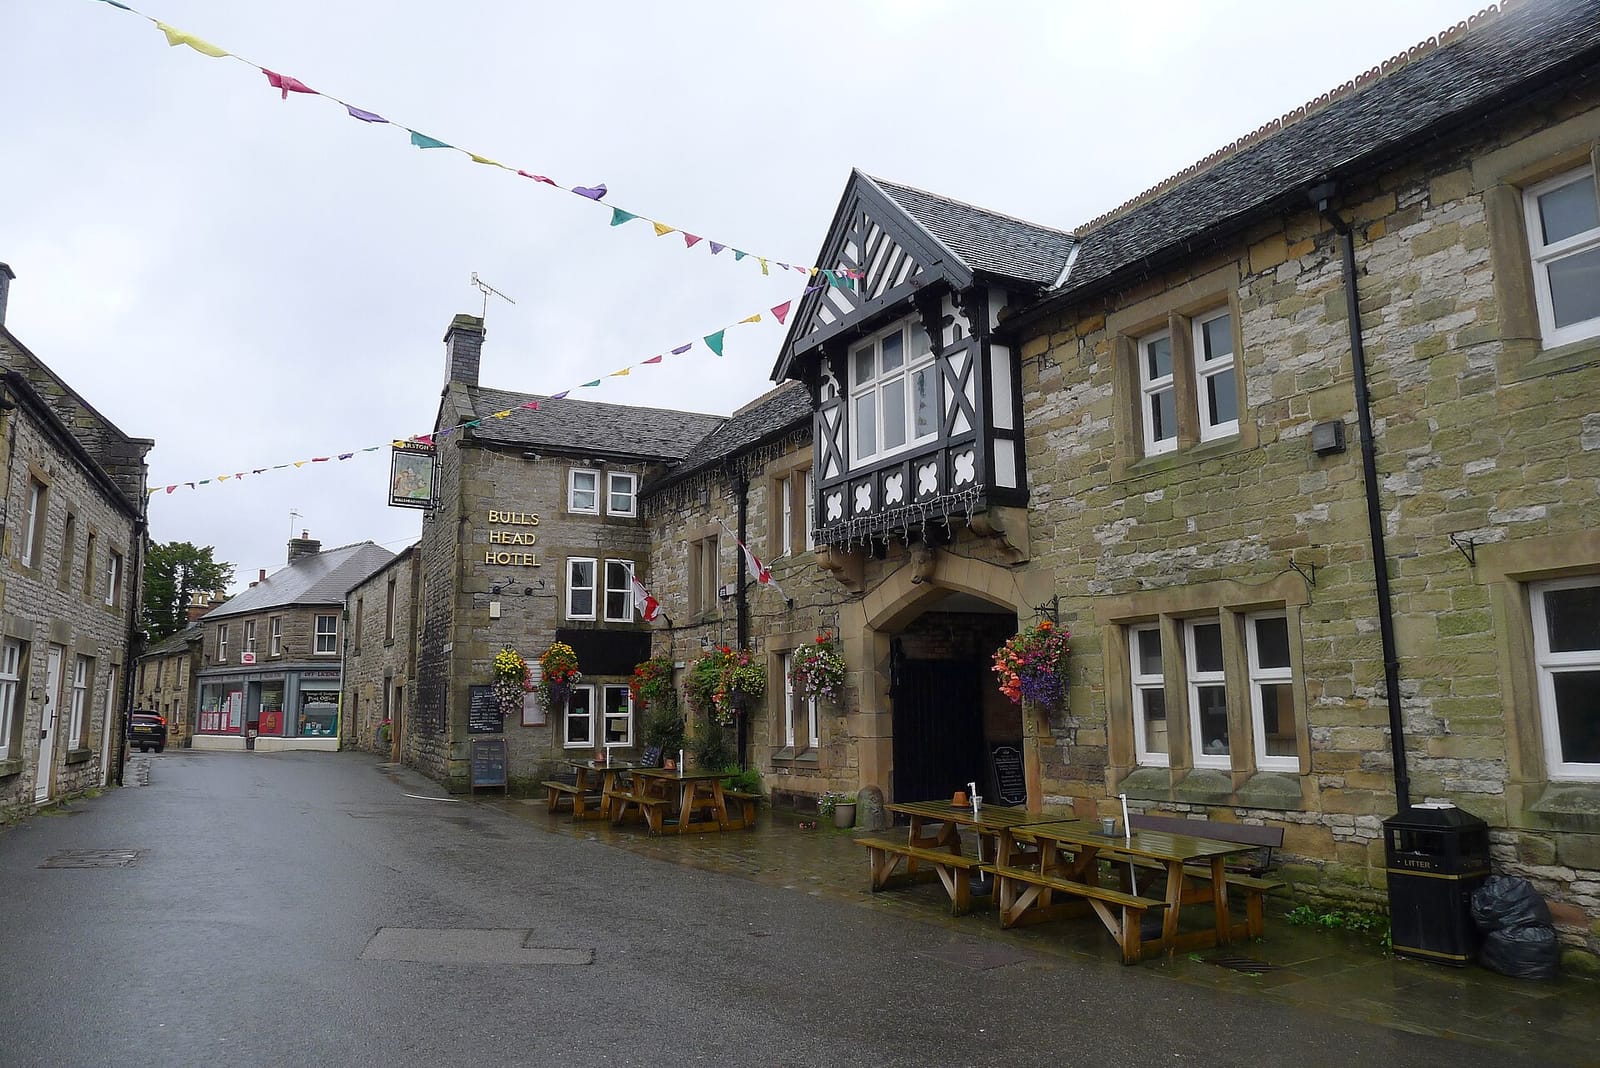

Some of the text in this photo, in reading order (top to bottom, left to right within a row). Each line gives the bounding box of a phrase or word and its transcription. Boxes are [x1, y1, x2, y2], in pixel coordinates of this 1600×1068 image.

[401, 441, 435, 451] ARSTONS
[488, 510, 539, 526] BULLS
[489, 530, 536, 545] HEAD
[485, 551, 541, 567] HOTEL
[1404, 859, 1431, 869] LITTER
